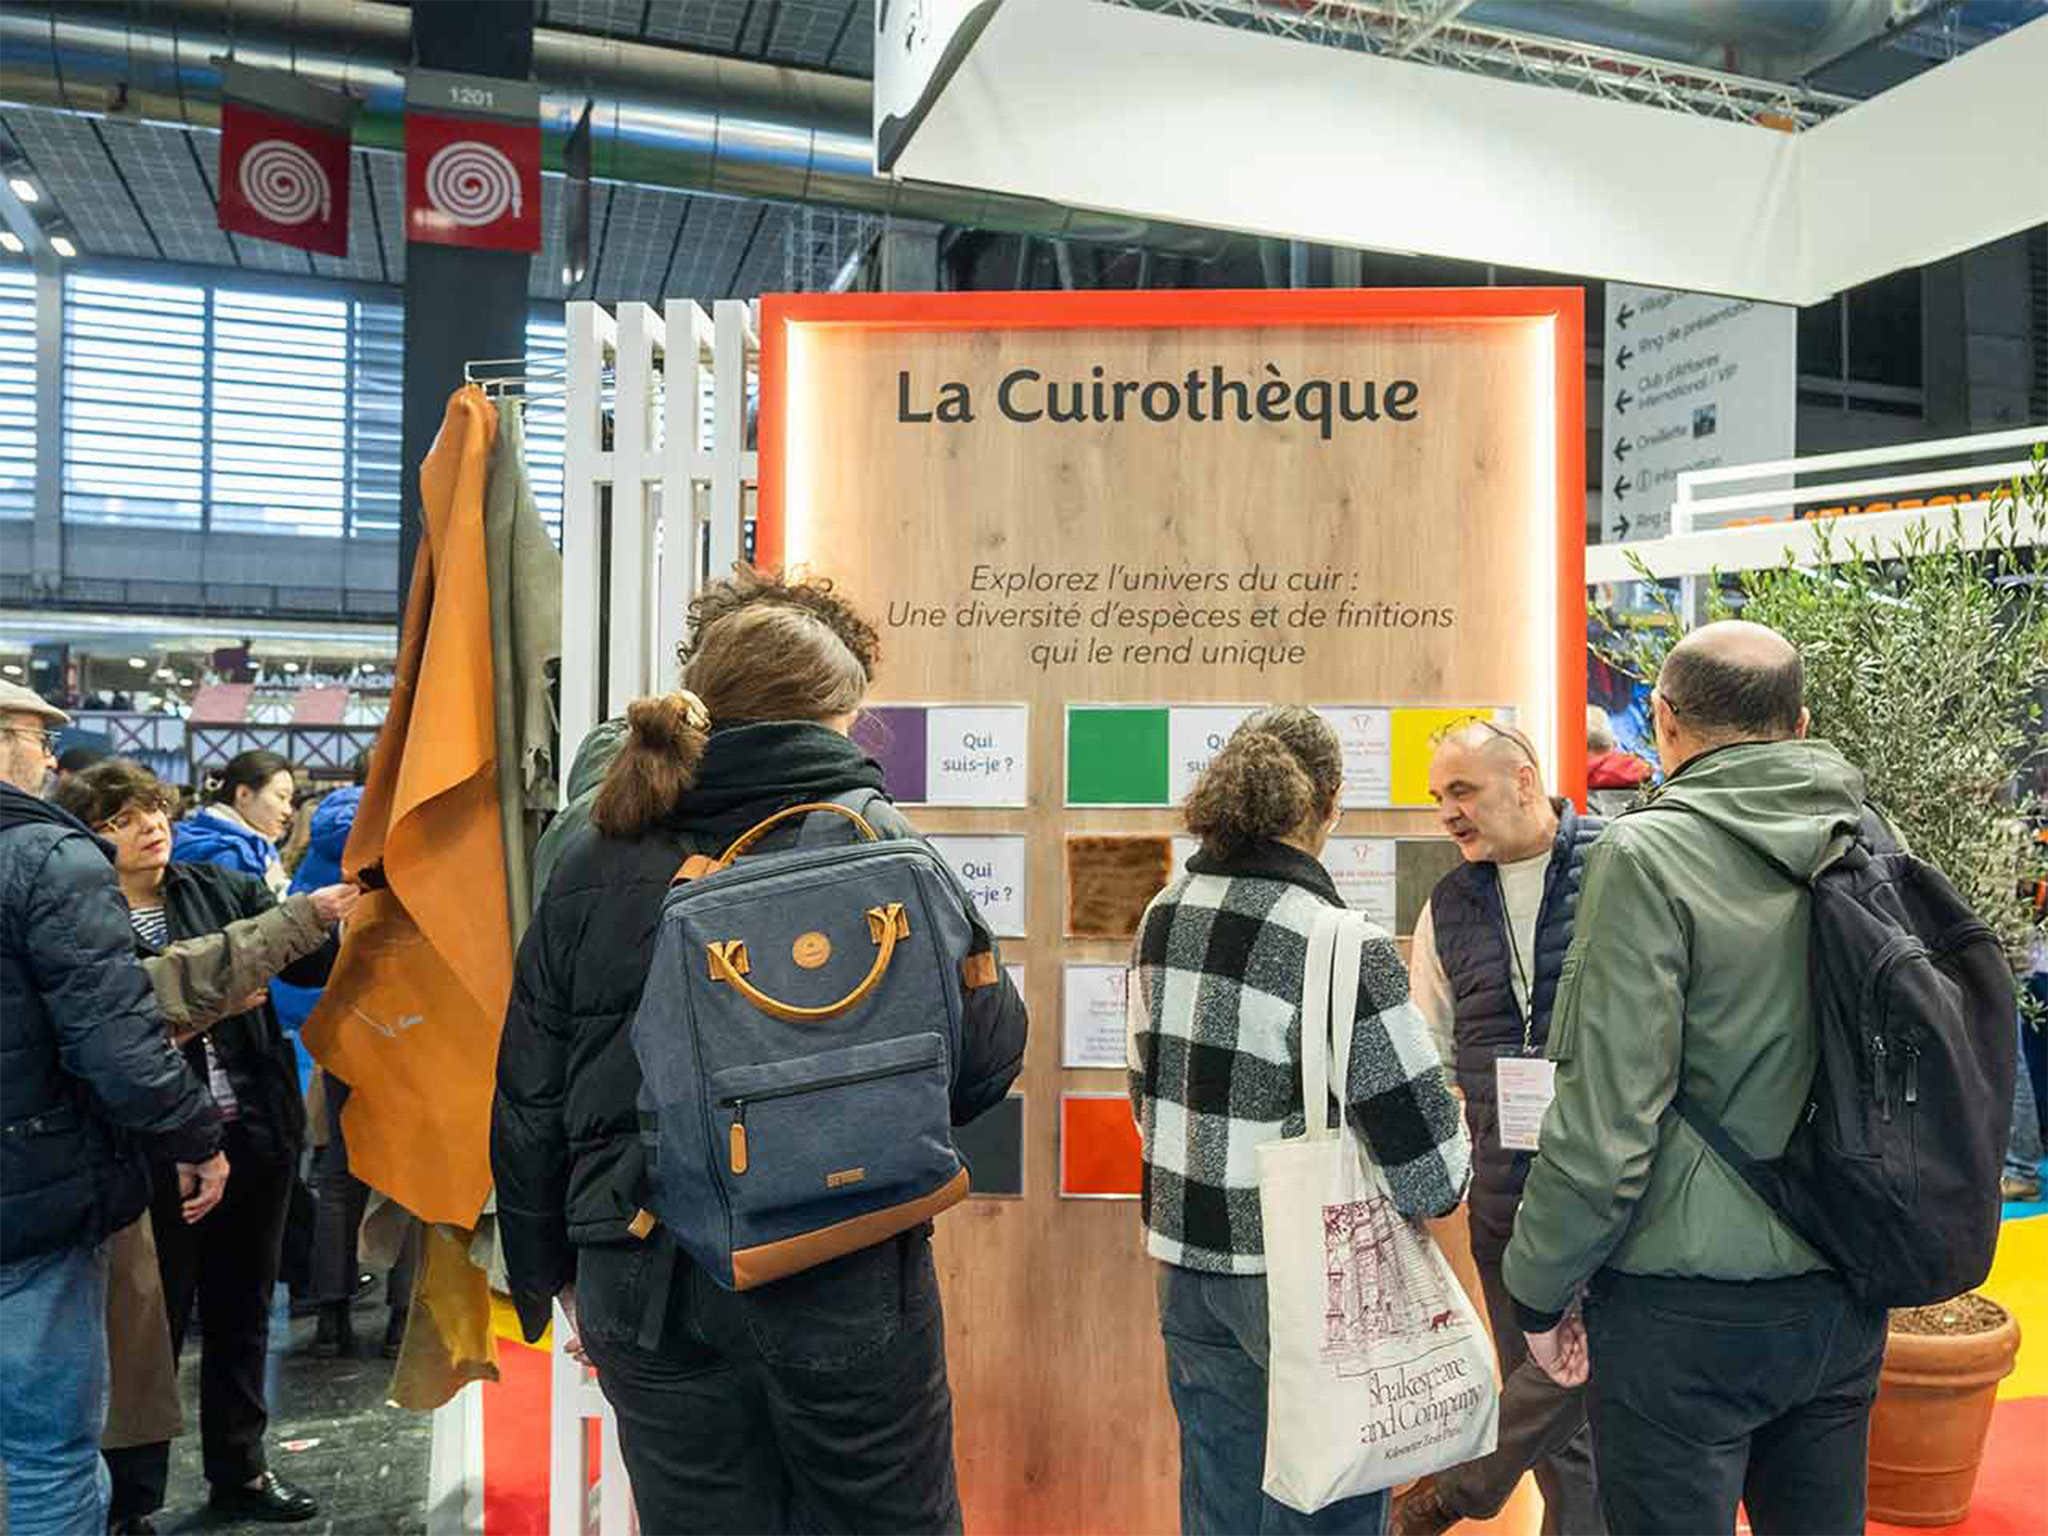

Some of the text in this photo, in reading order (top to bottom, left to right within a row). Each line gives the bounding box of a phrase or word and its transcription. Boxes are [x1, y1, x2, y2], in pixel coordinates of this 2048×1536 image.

[449, 87, 494, 106] 1201
[898, 362, 1419, 440] La Cuirothèque
[970, 562, 1359, 597] Explorez l'univers du cuir :
[886, 599, 1454, 632] Une diversité d'espèces et de finitions
[1031, 634, 1306, 667] qui le rend unique
[962, 732, 993, 751] Qui
[942, 756, 1015, 776] suis-je ?
[961, 861, 993, 879] Qui
[1003, 886, 1014, 902] ?
[1360, 1403, 1398, 1445] and
